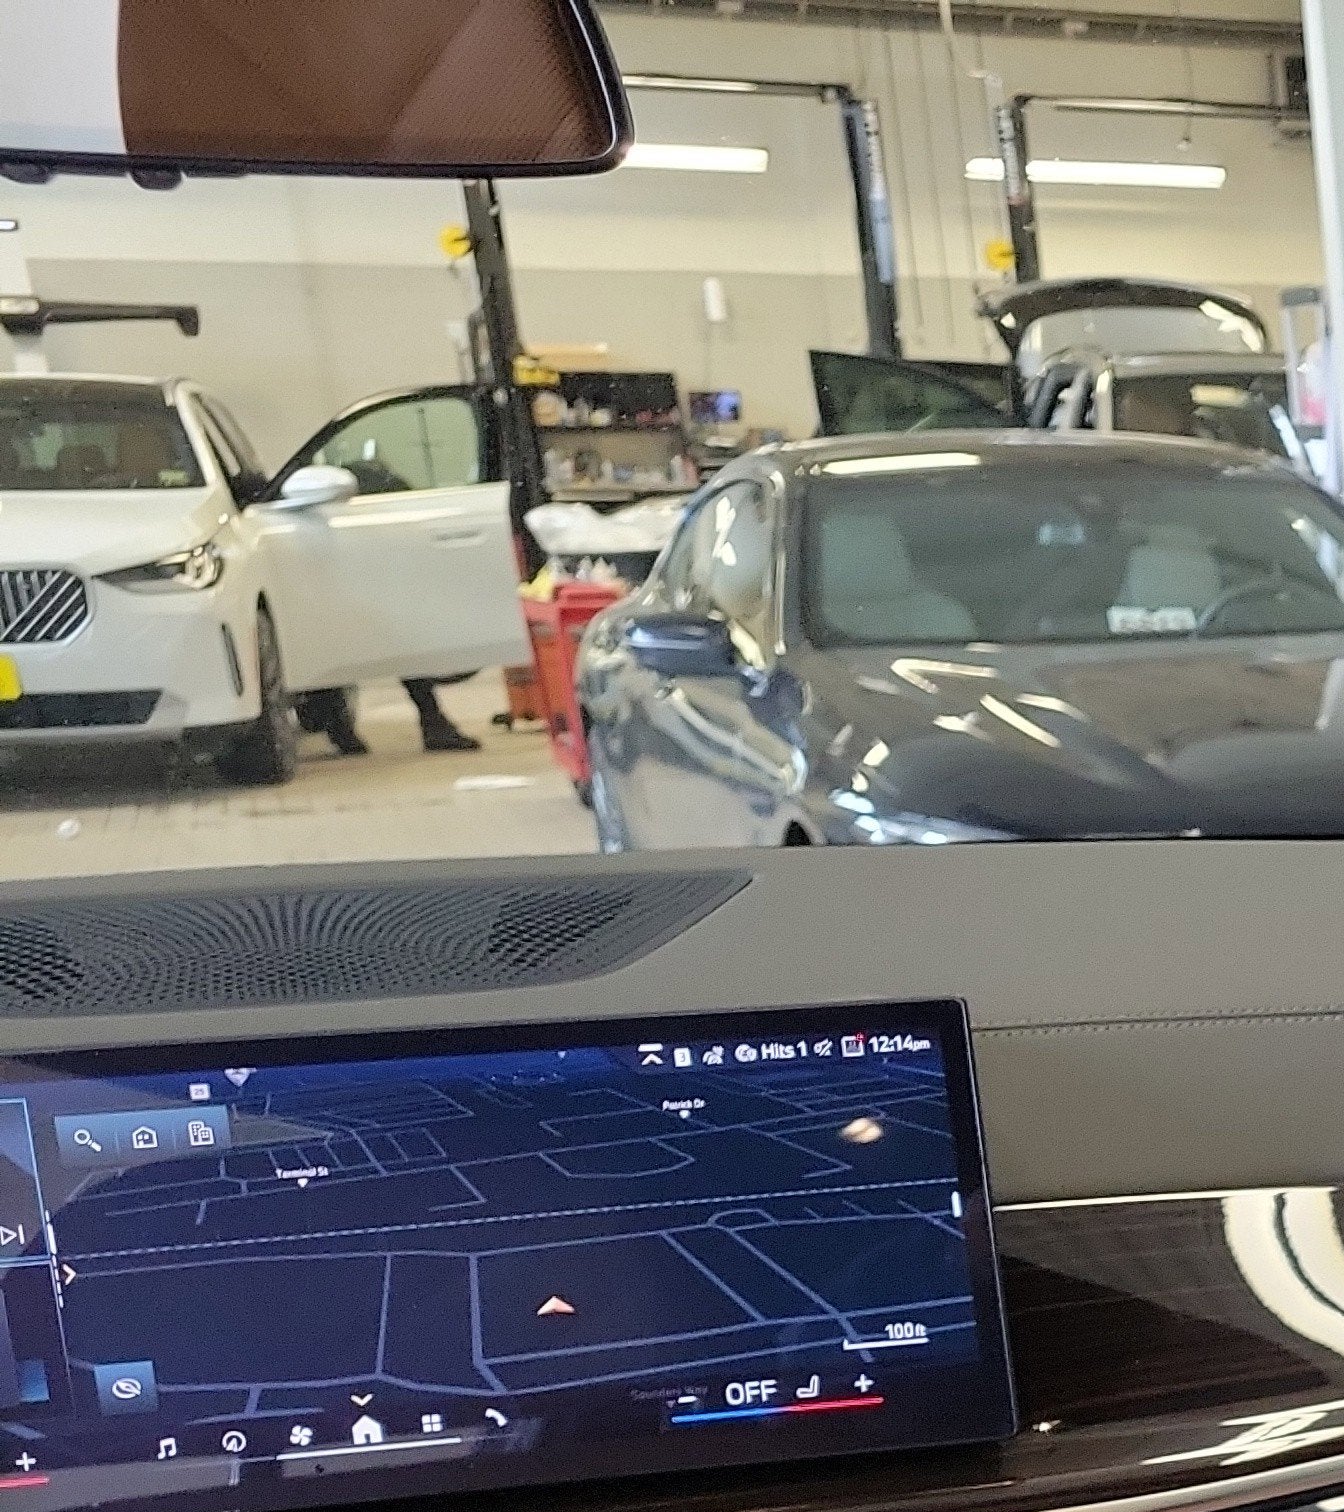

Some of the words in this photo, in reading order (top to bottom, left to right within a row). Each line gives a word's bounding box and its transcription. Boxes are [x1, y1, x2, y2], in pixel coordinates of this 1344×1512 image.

[761, 1042, 796, 1060] Hits
[797, 1040, 807, 1057] 1
[868, 1034, 931, 1053] 12:14pm
[725, 1378, 778, 1406] OFF
